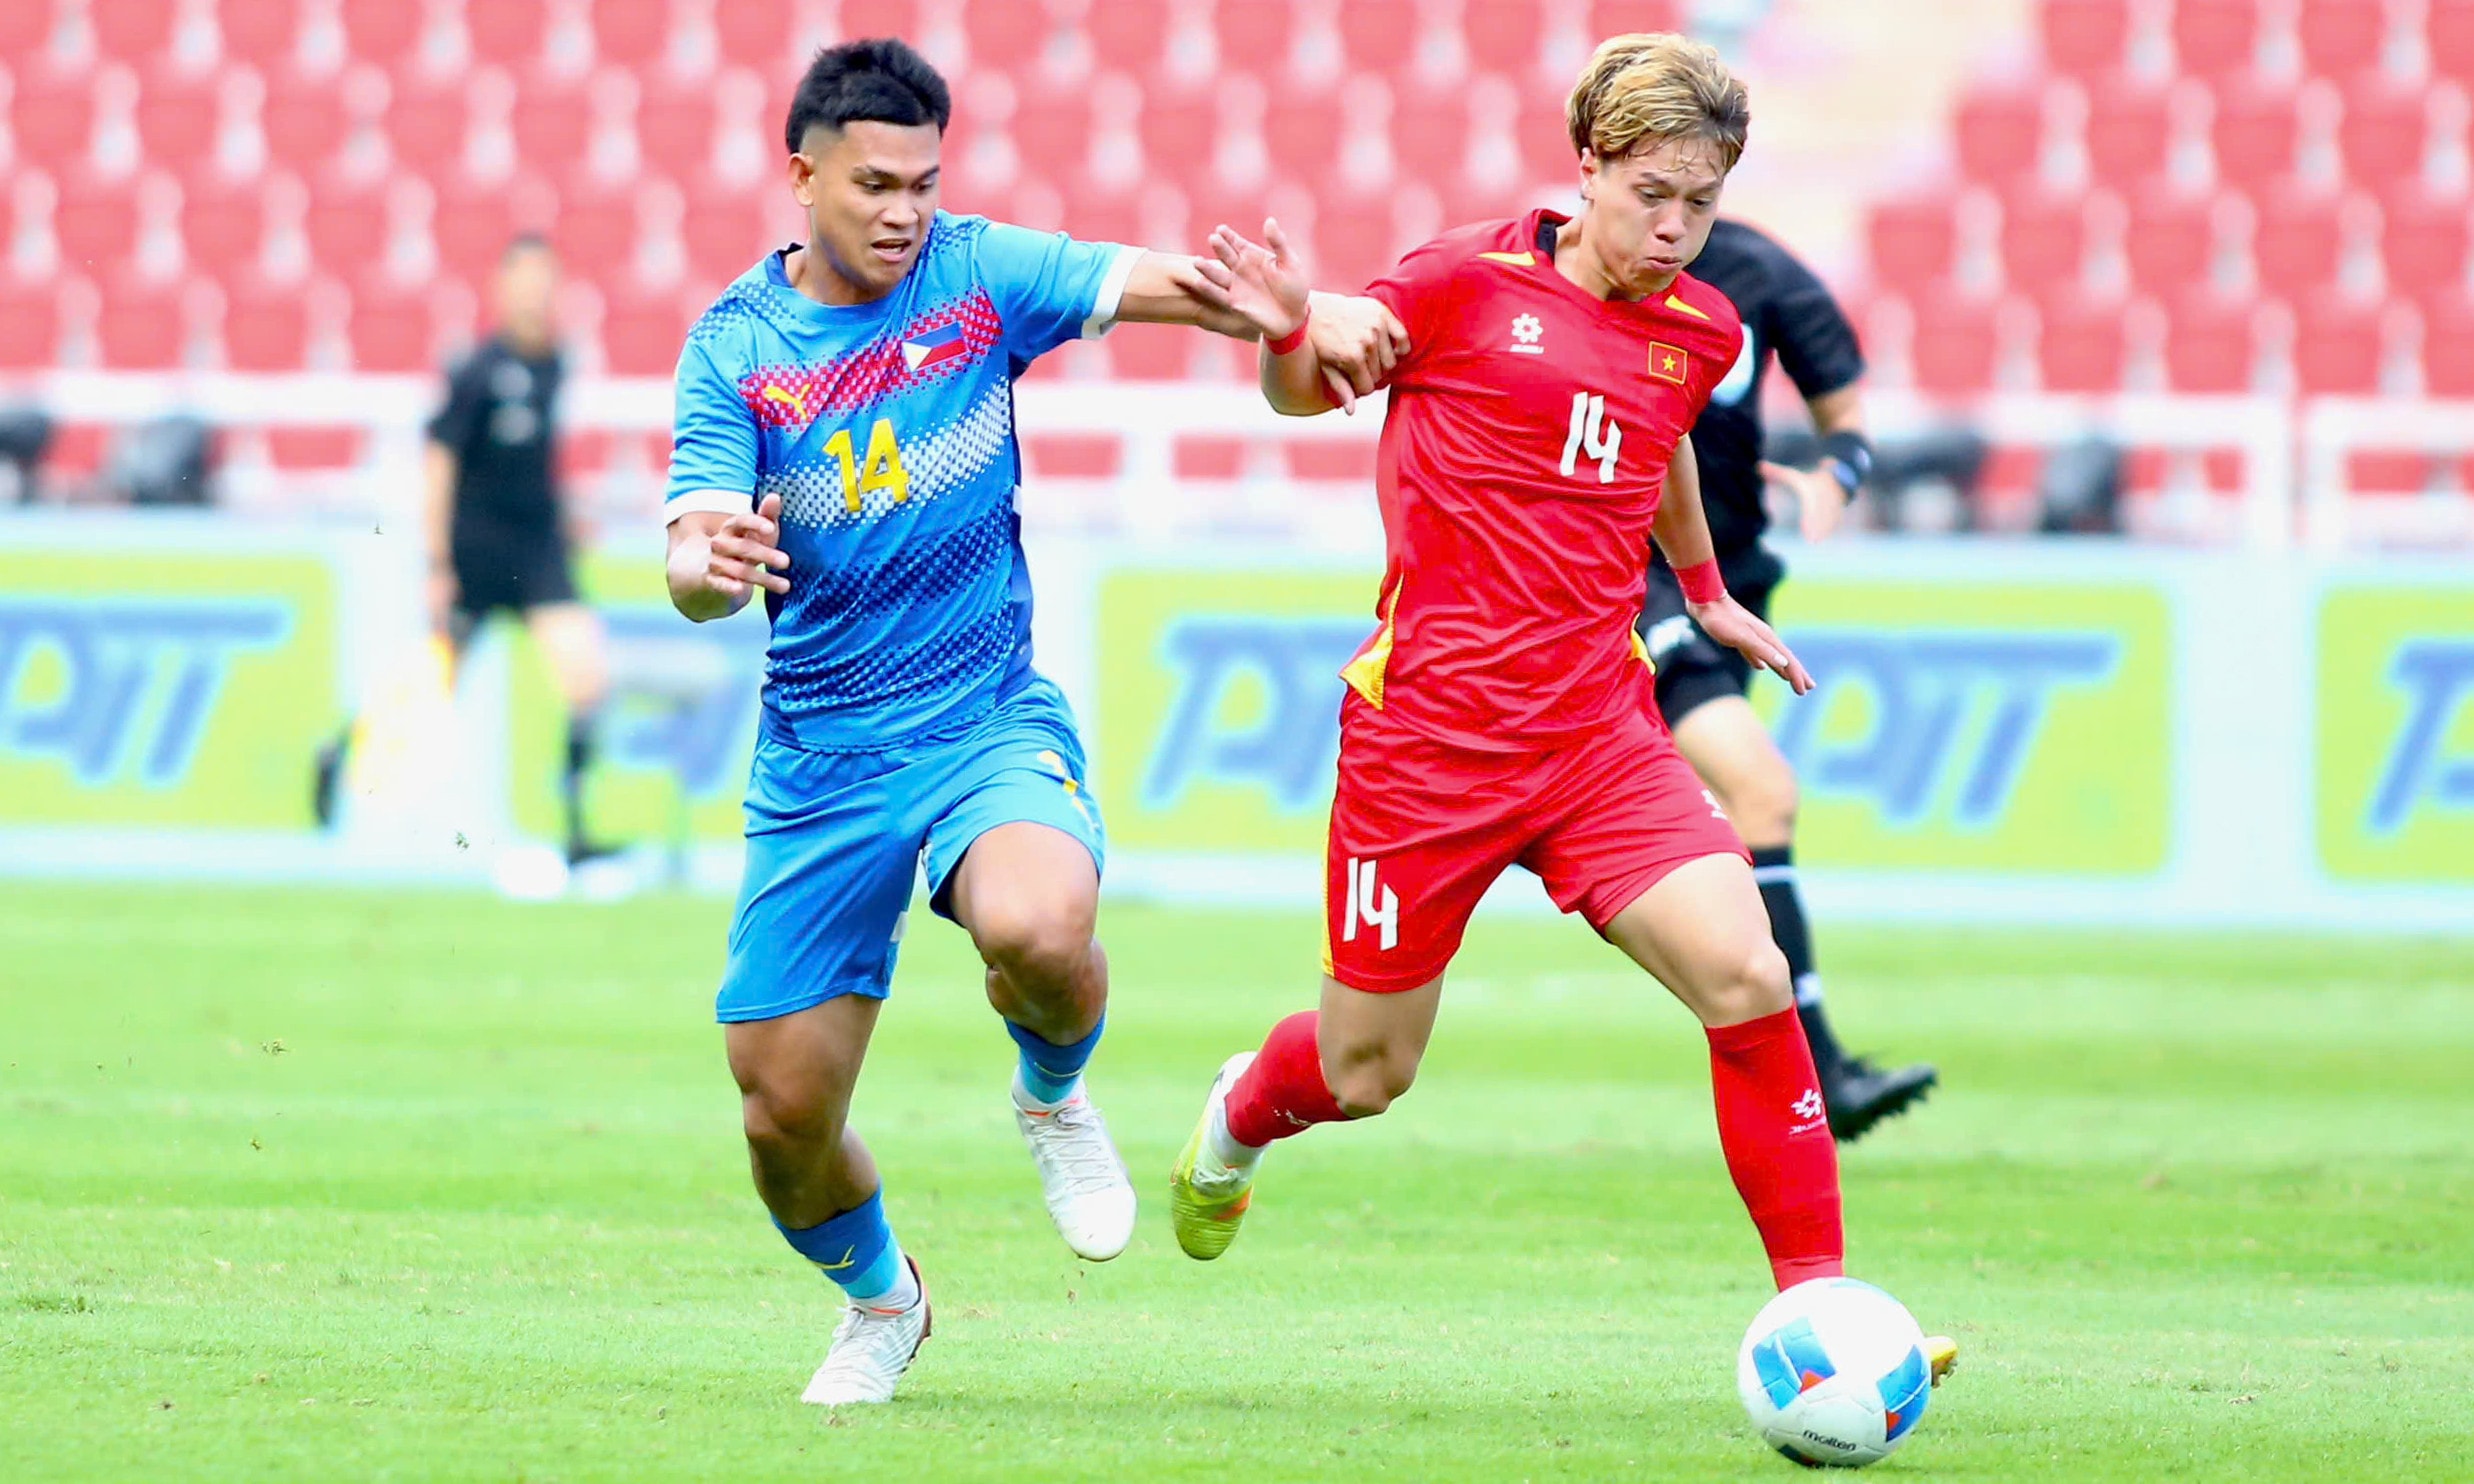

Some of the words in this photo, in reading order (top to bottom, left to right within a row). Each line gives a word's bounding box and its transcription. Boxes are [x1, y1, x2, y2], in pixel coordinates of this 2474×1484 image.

[823, 418, 910, 512] 14
[1560, 391, 1622, 484] 14
[1343, 856, 1400, 951] 14
[1802, 1430, 1857, 1451] molten
